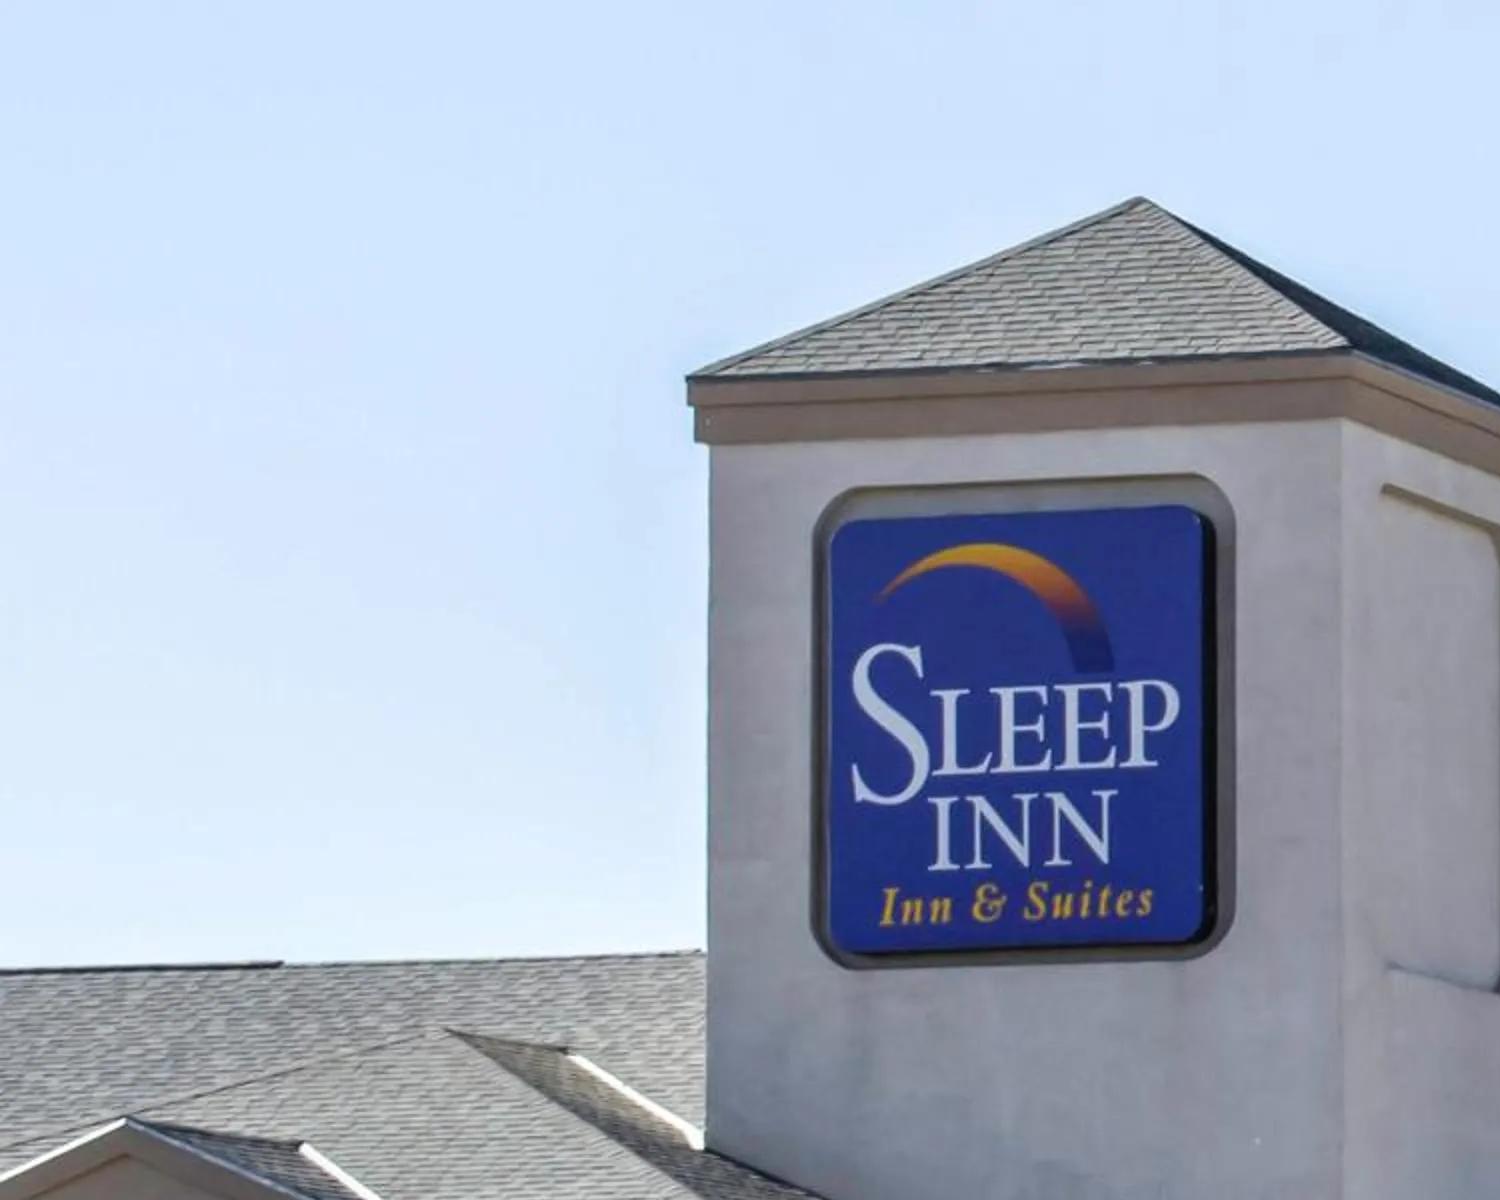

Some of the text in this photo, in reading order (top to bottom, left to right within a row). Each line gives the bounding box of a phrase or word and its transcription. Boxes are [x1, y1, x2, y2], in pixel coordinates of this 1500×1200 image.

[851, 642, 1181, 805] SLEEP
[927, 789, 1118, 871] INN
[879, 881, 1154, 926] Inn & Suites
